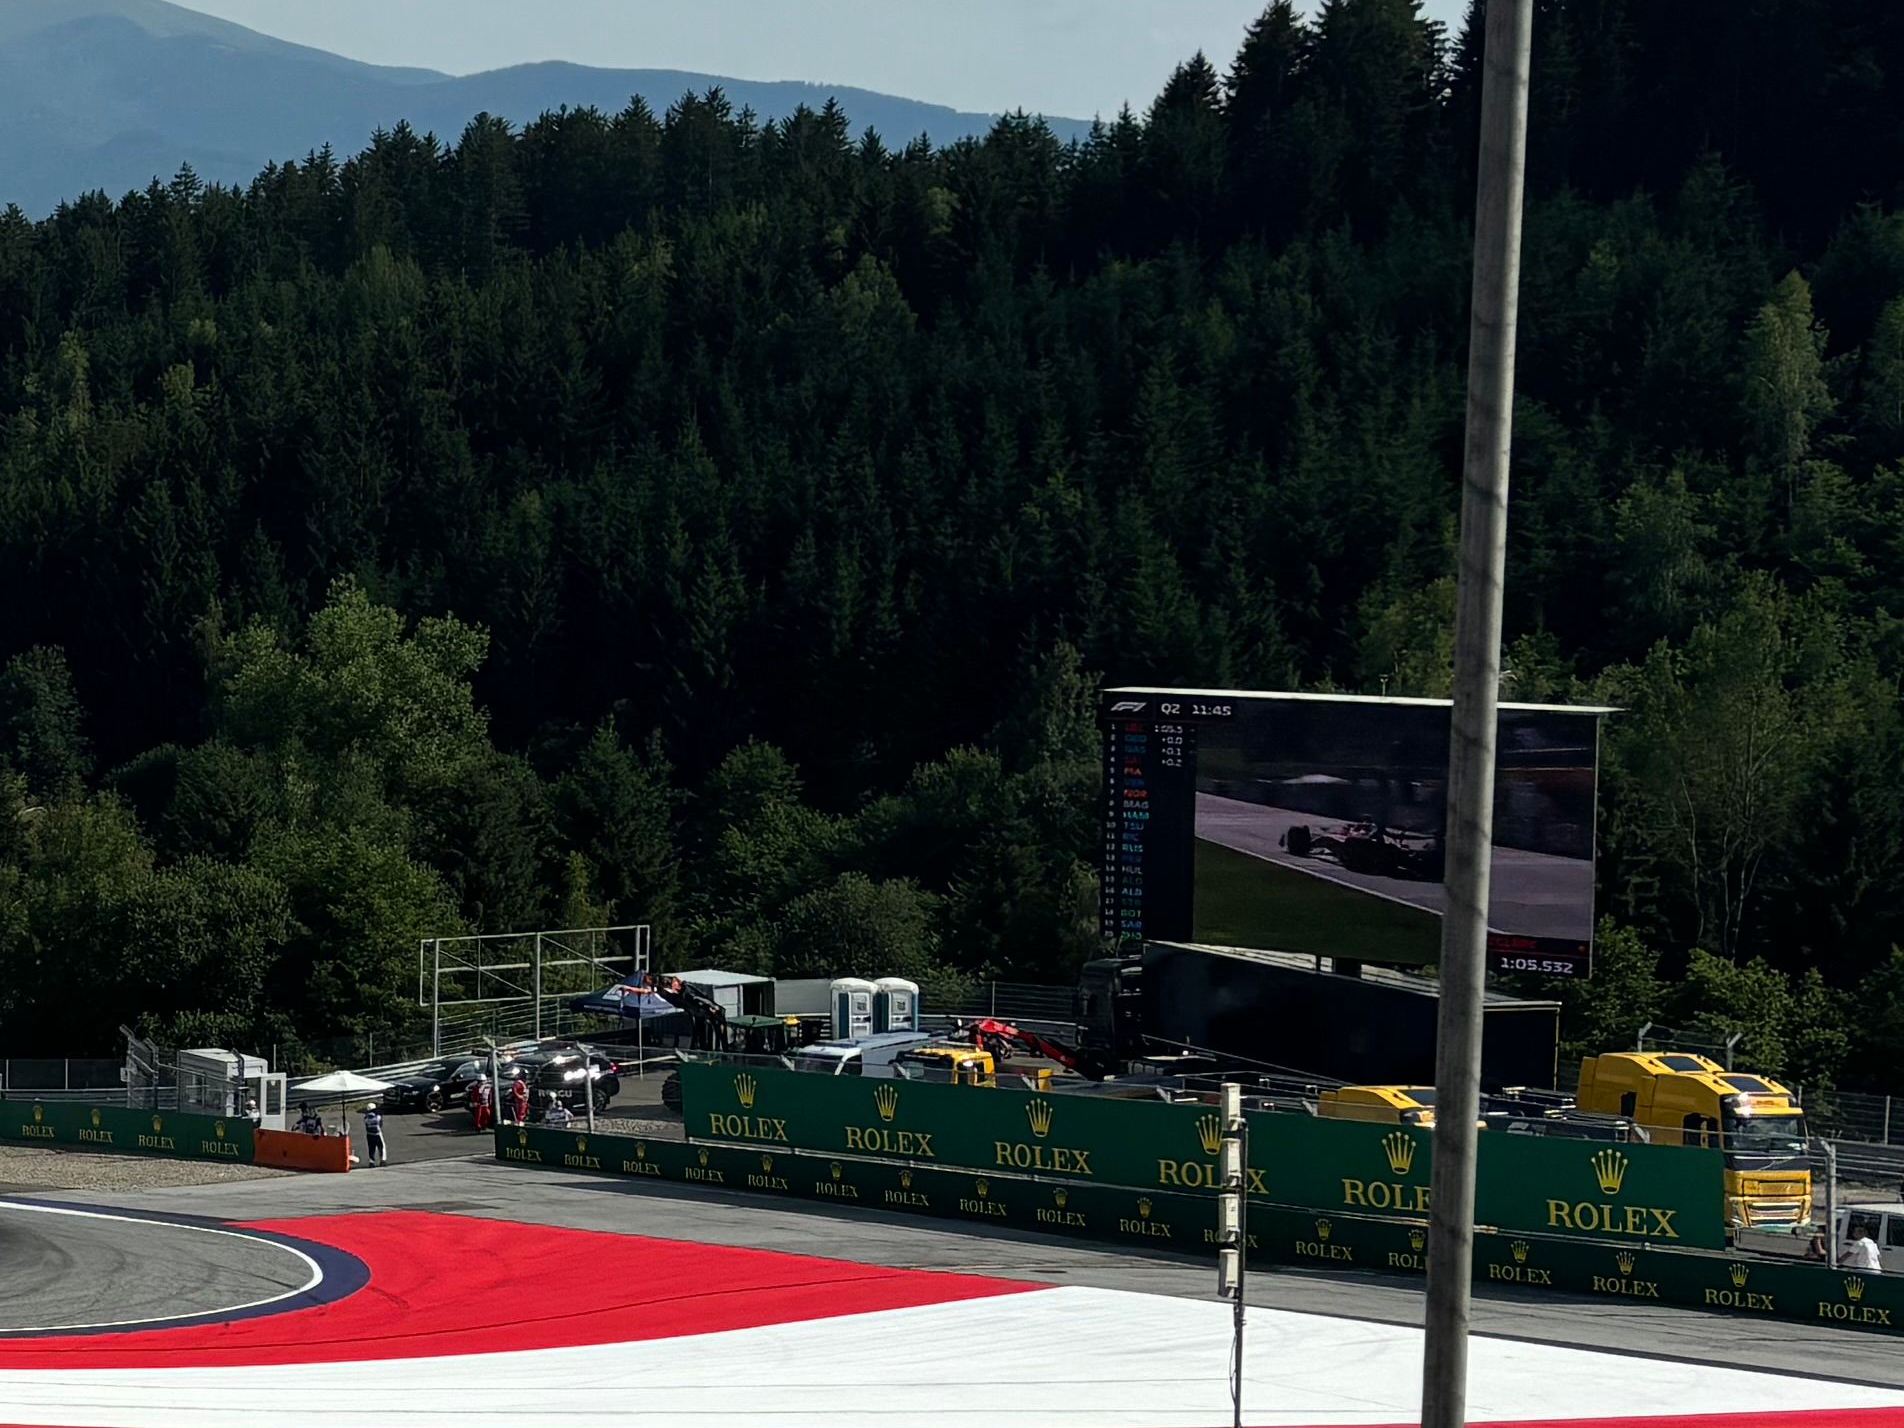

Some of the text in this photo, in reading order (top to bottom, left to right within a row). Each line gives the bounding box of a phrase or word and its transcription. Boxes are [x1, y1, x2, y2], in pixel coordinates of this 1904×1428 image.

[1161, 703, 1181, 715] Q2
[1192, 704, 1232, 716] 11:45
[1500, 957, 1573, 974] 1:05.532
[22, 1125, 55, 1138] ROLEX
[79, 1128, 113, 1143] ROLEX
[709, 1113, 789, 1142] ROLEX
[138, 1135, 175, 1149] ROLEX
[202, 1140, 239, 1156] ROLEX
[846, 1127, 935, 1157] ROLEX
[506, 1147, 542, 1162] ROLEX
[564, 1154, 600, 1169] ROLEX
[995, 1141, 1092, 1174] ROLEX
[623, 1160, 660, 1175] ROLEX
[685, 1167, 724, 1183] ROLEX
[748, 1174, 788, 1190] ROLEX
[1158, 1159, 1270, 1194] ROLX
[816, 1182, 858, 1198] ROLEX
[885, 1190, 930, 1206] ROLEX
[1342, 1179, 1431, 1213] ROLE
[960, 1198, 1007, 1216] ROLEX
[1037, 1209, 1086, 1227] ROLEX
[1546, 1199, 1680, 1238] ROLEX
[1120, 1219, 1172, 1237] ROLEX
[1296, 1241, 1353, 1260] ROLEX
[1388, 1252, 1427, 1269] ROL
[1489, 1264, 1552, 1284] ROLEX
[1593, 1276, 1659, 1297] ROLEX
[1705, 1289, 1775, 1310] ROLEX
[1818, 1302, 1892, 1325] ROLEX
